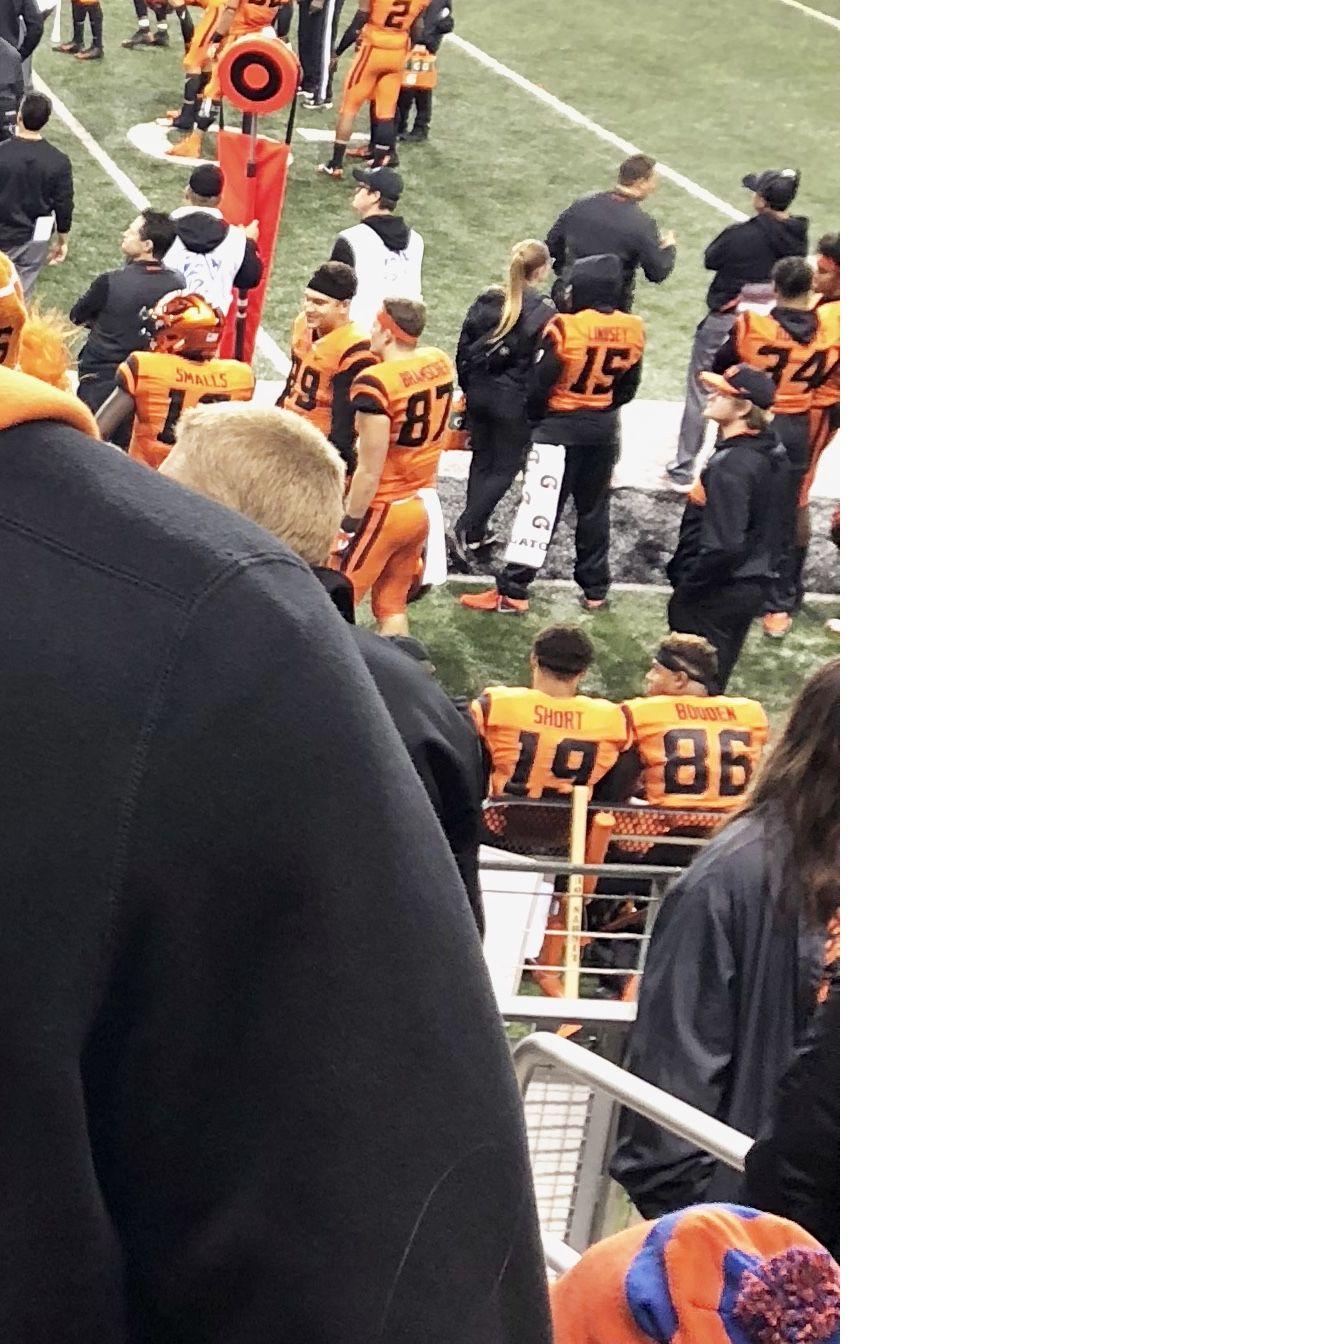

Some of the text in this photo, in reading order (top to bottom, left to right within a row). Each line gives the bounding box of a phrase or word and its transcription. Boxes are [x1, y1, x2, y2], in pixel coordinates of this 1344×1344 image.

[175, 367, 229, 389] SMALLS
[570, 345, 631, 395] 15
[396, 381, 454, 448] 87
[533, 704, 584, 731] SHORT
[503, 729, 599, 801] 19
[663, 727, 754, 796] 86
